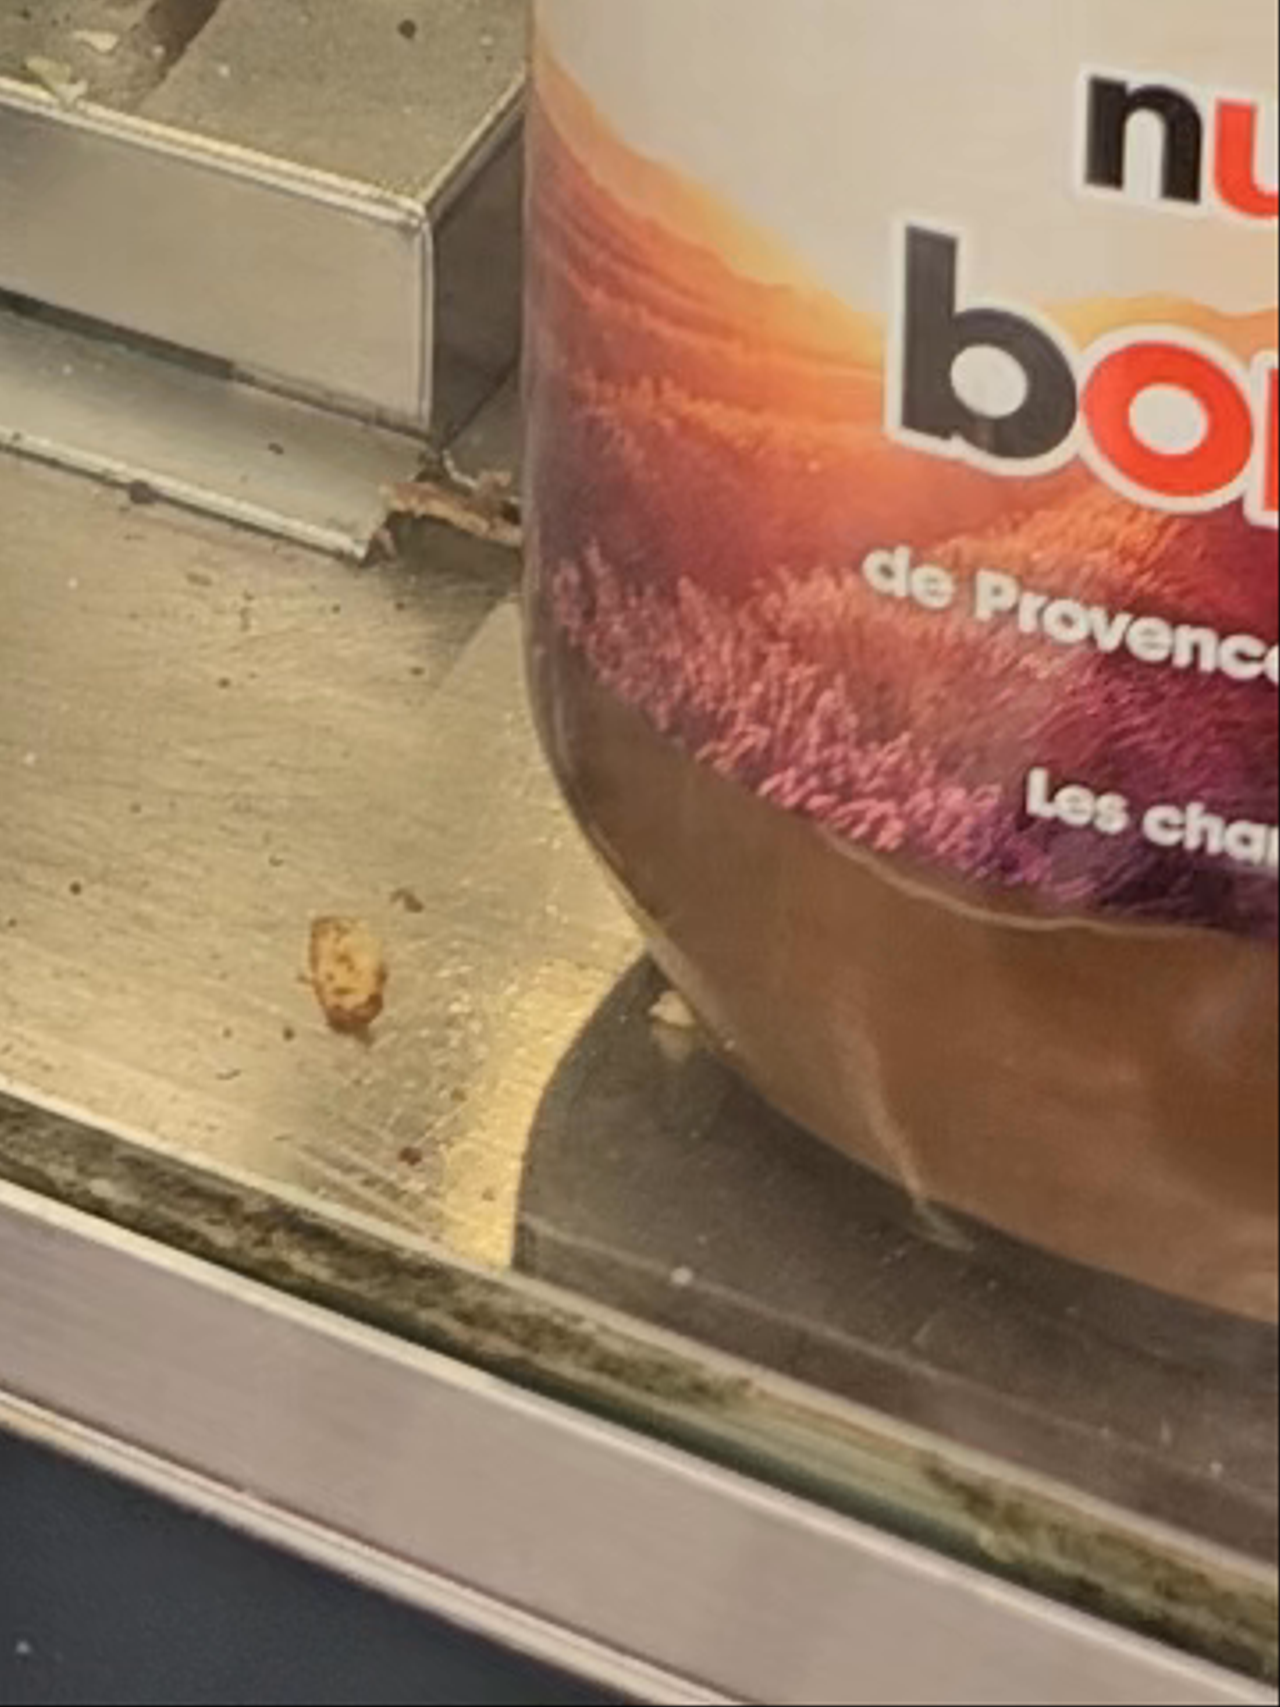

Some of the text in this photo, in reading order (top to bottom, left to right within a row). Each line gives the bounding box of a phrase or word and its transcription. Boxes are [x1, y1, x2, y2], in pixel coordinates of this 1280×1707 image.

[900, 223, 1278, 512] bo
[862, 545, 955, 609] de
[1025, 767, 1130, 835] Les
